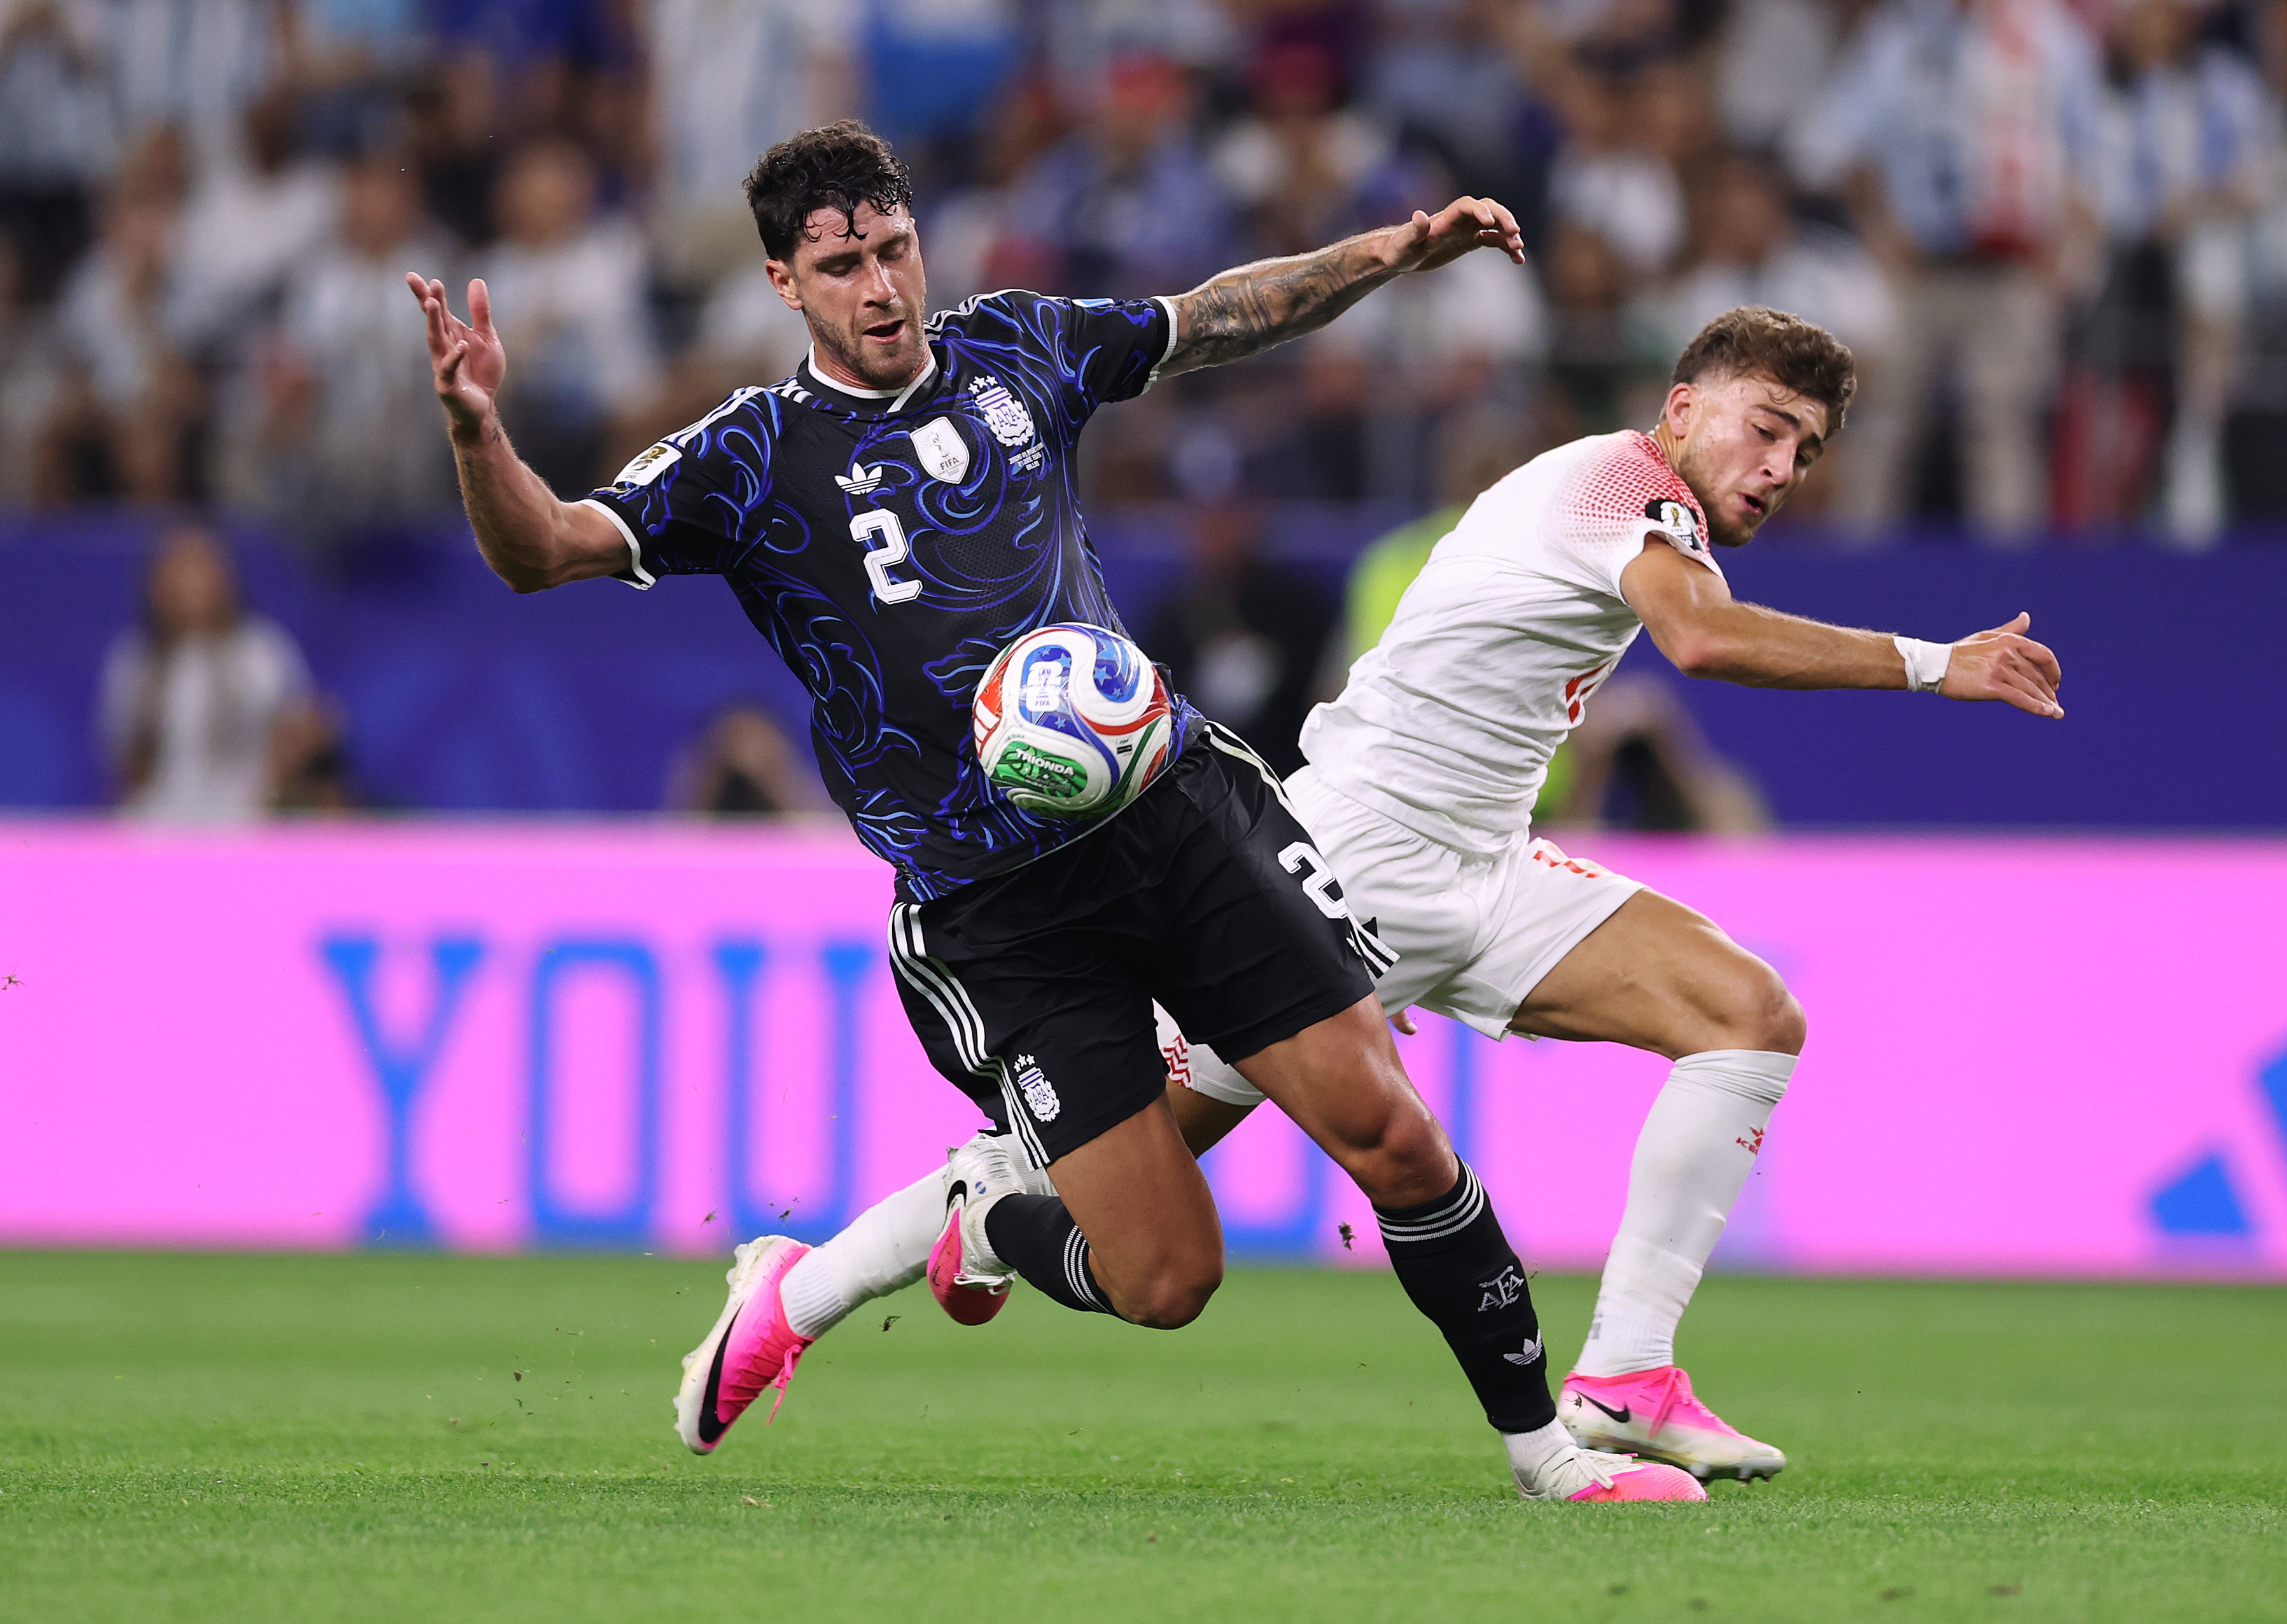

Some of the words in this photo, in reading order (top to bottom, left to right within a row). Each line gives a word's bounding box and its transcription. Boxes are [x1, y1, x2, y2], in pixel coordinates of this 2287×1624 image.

[940, 457, 960, 470] FIFA
[948, 468, 959, 476] 2022
[850, 508, 923, 605] 2
[1016, 748, 1075, 776] TRIONDA
[1277, 841, 1348, 920] 2
[321, 937, 874, 1244] YOU
